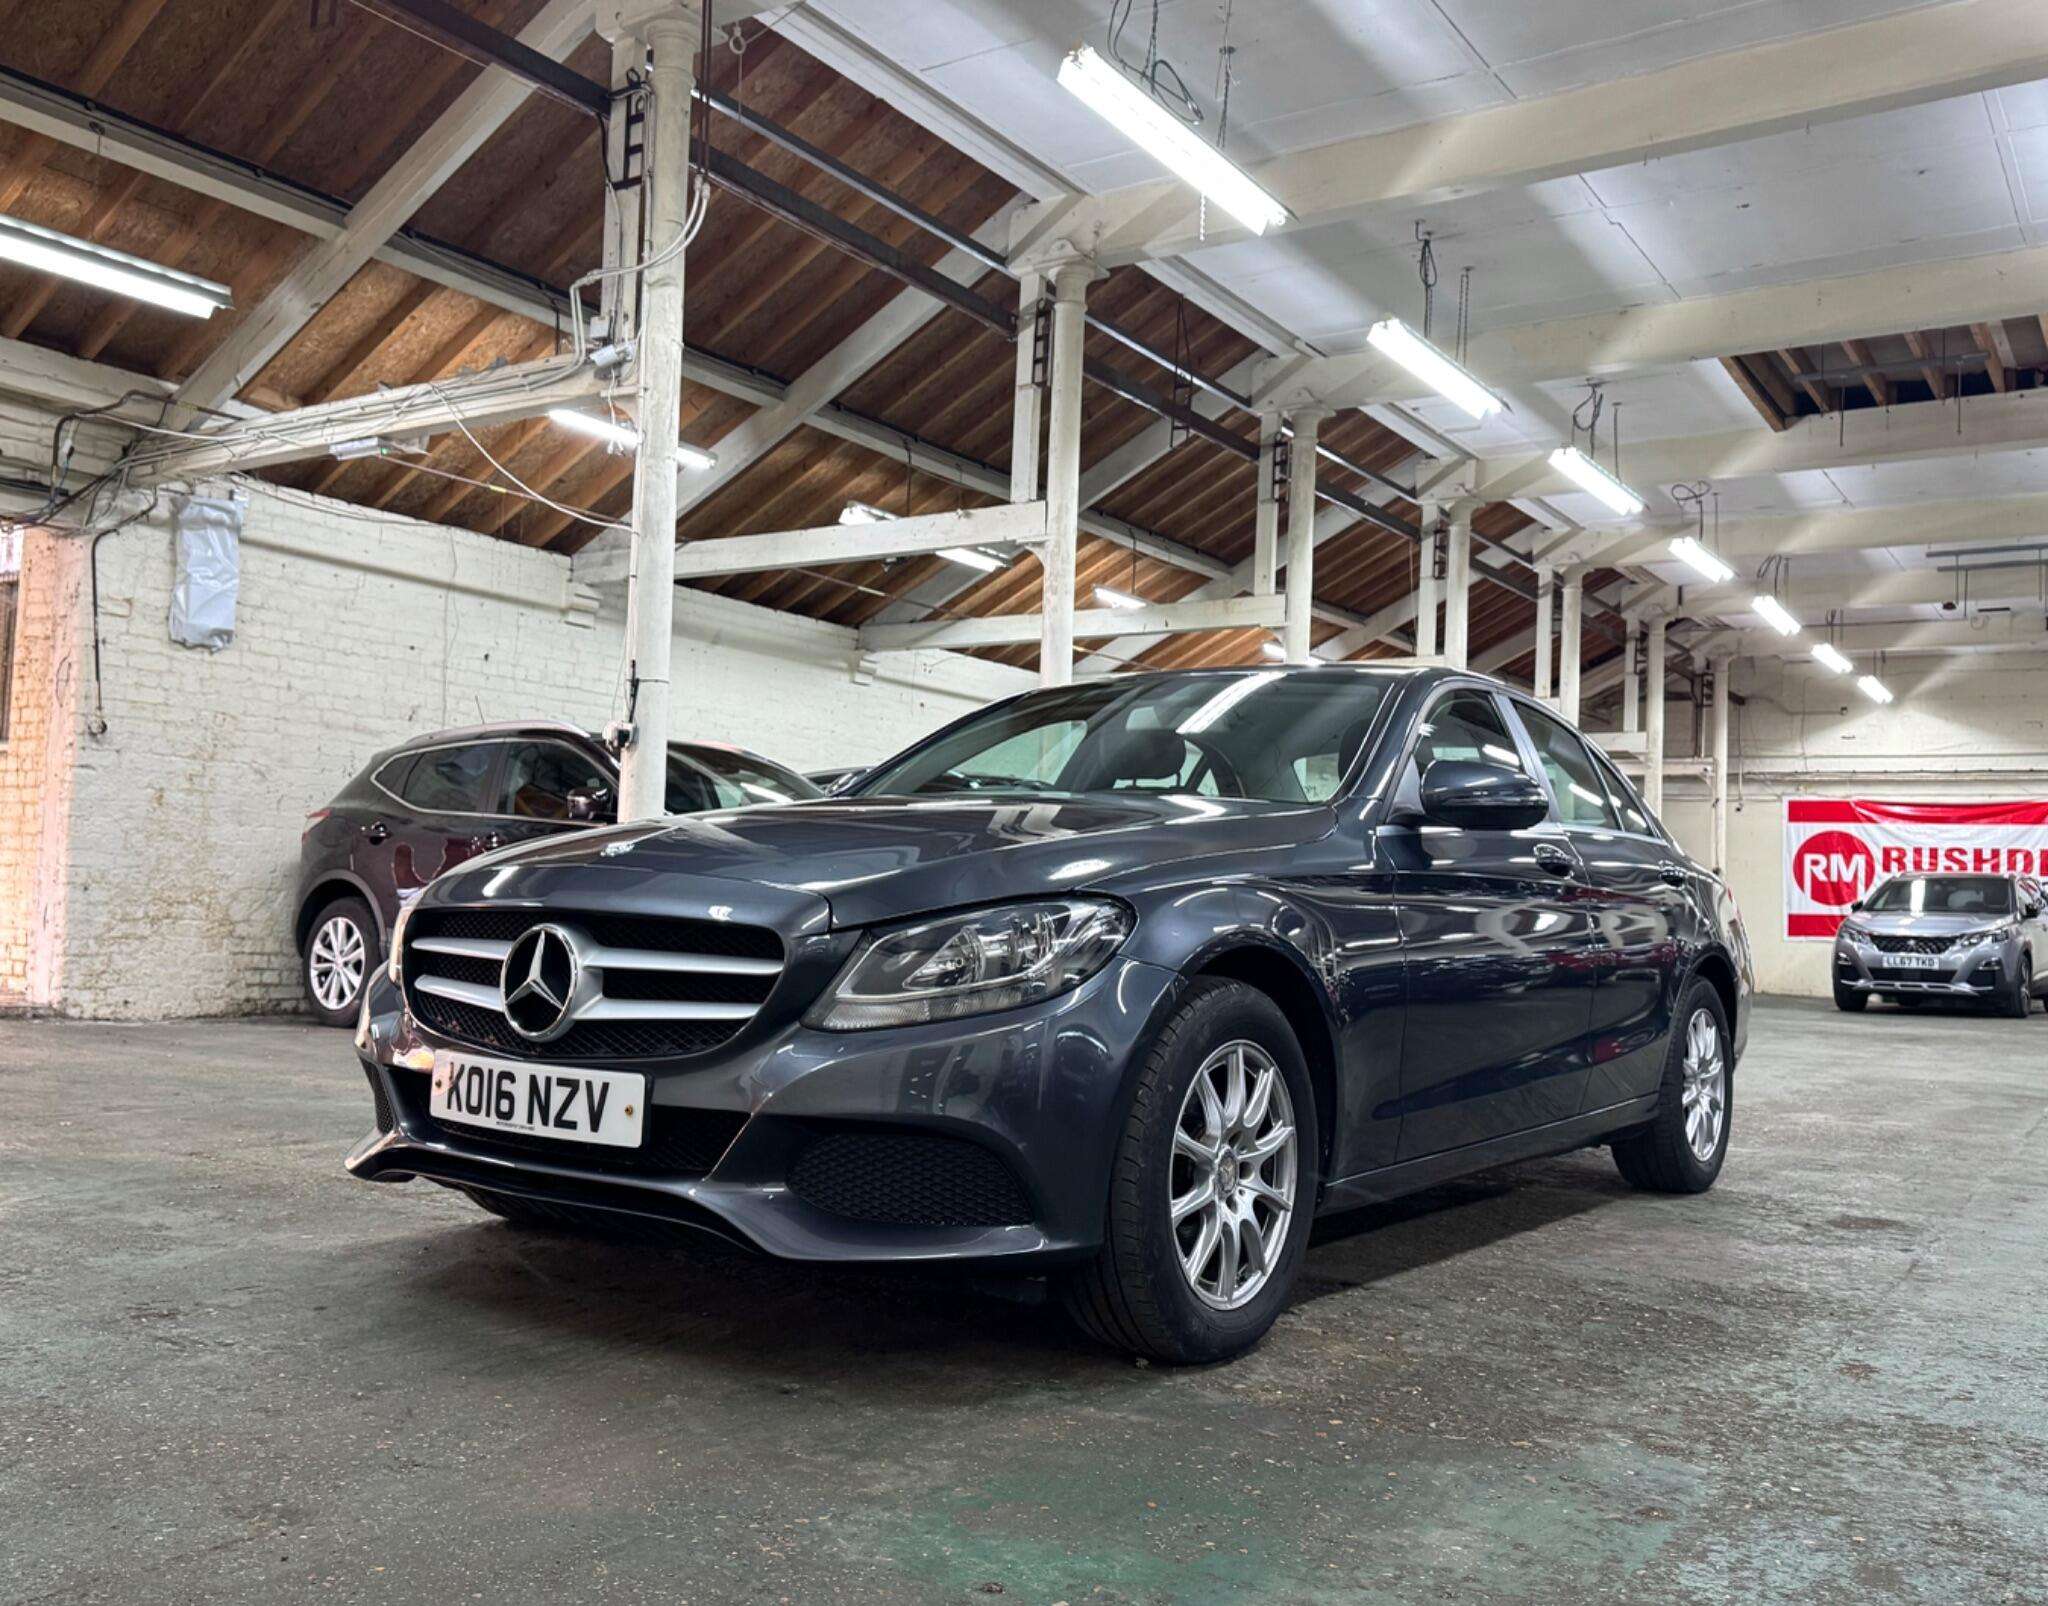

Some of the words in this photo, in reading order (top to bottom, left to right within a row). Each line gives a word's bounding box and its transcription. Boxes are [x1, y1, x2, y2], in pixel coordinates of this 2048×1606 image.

[1803, 853, 1866, 888] RM
[447, 1062, 516, 1121] KO16
[527, 1074, 610, 1133] NZV
